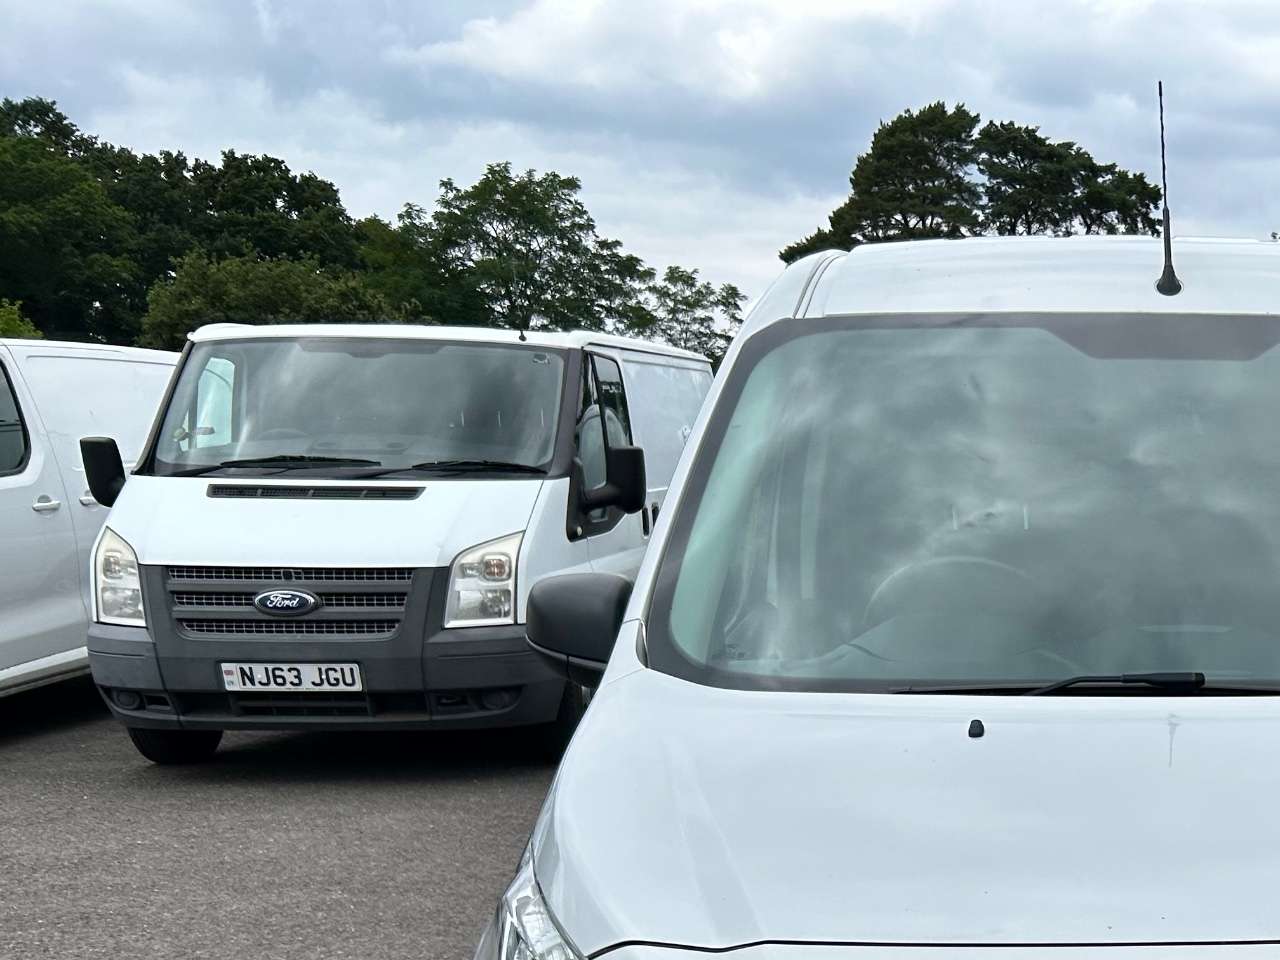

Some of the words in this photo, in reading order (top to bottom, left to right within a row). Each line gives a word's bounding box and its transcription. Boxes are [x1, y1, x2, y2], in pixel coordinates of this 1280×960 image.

[267, 593, 300, 608] Ford
[239, 666, 302, 687] NJ63
[311, 667, 356, 687] JGU
